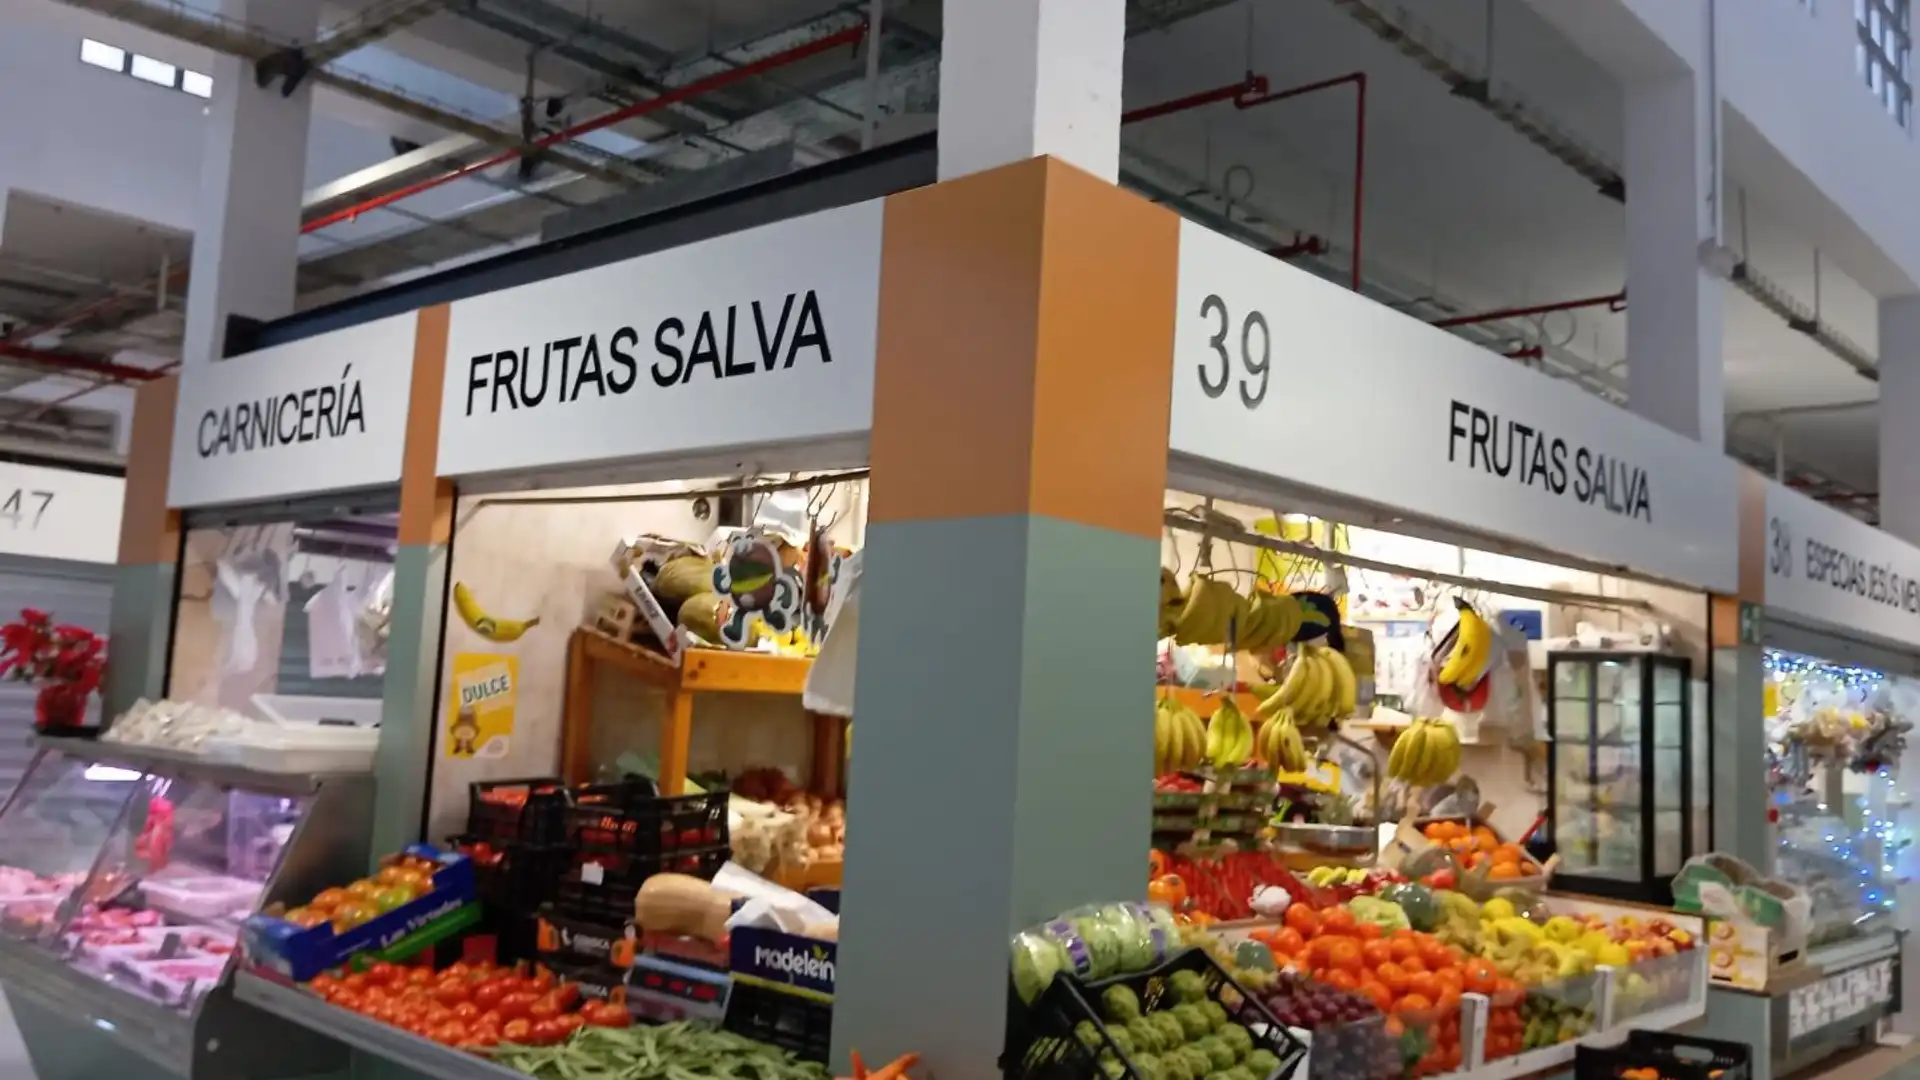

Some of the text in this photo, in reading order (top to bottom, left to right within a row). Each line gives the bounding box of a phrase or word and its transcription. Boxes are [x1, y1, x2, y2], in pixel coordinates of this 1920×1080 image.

[466, 289, 832, 416] FRUTAS SALVA
[1198, 294, 1269, 410] 39
[198, 362, 365, 458] CARNICERÍA
[0, 488, 54, 531] 47
[1449, 399, 1652, 524] FRUTAS SALVA
[1806, 538, 1866, 597] ESPECIAS
[462, 675, 510, 703] DULCE
